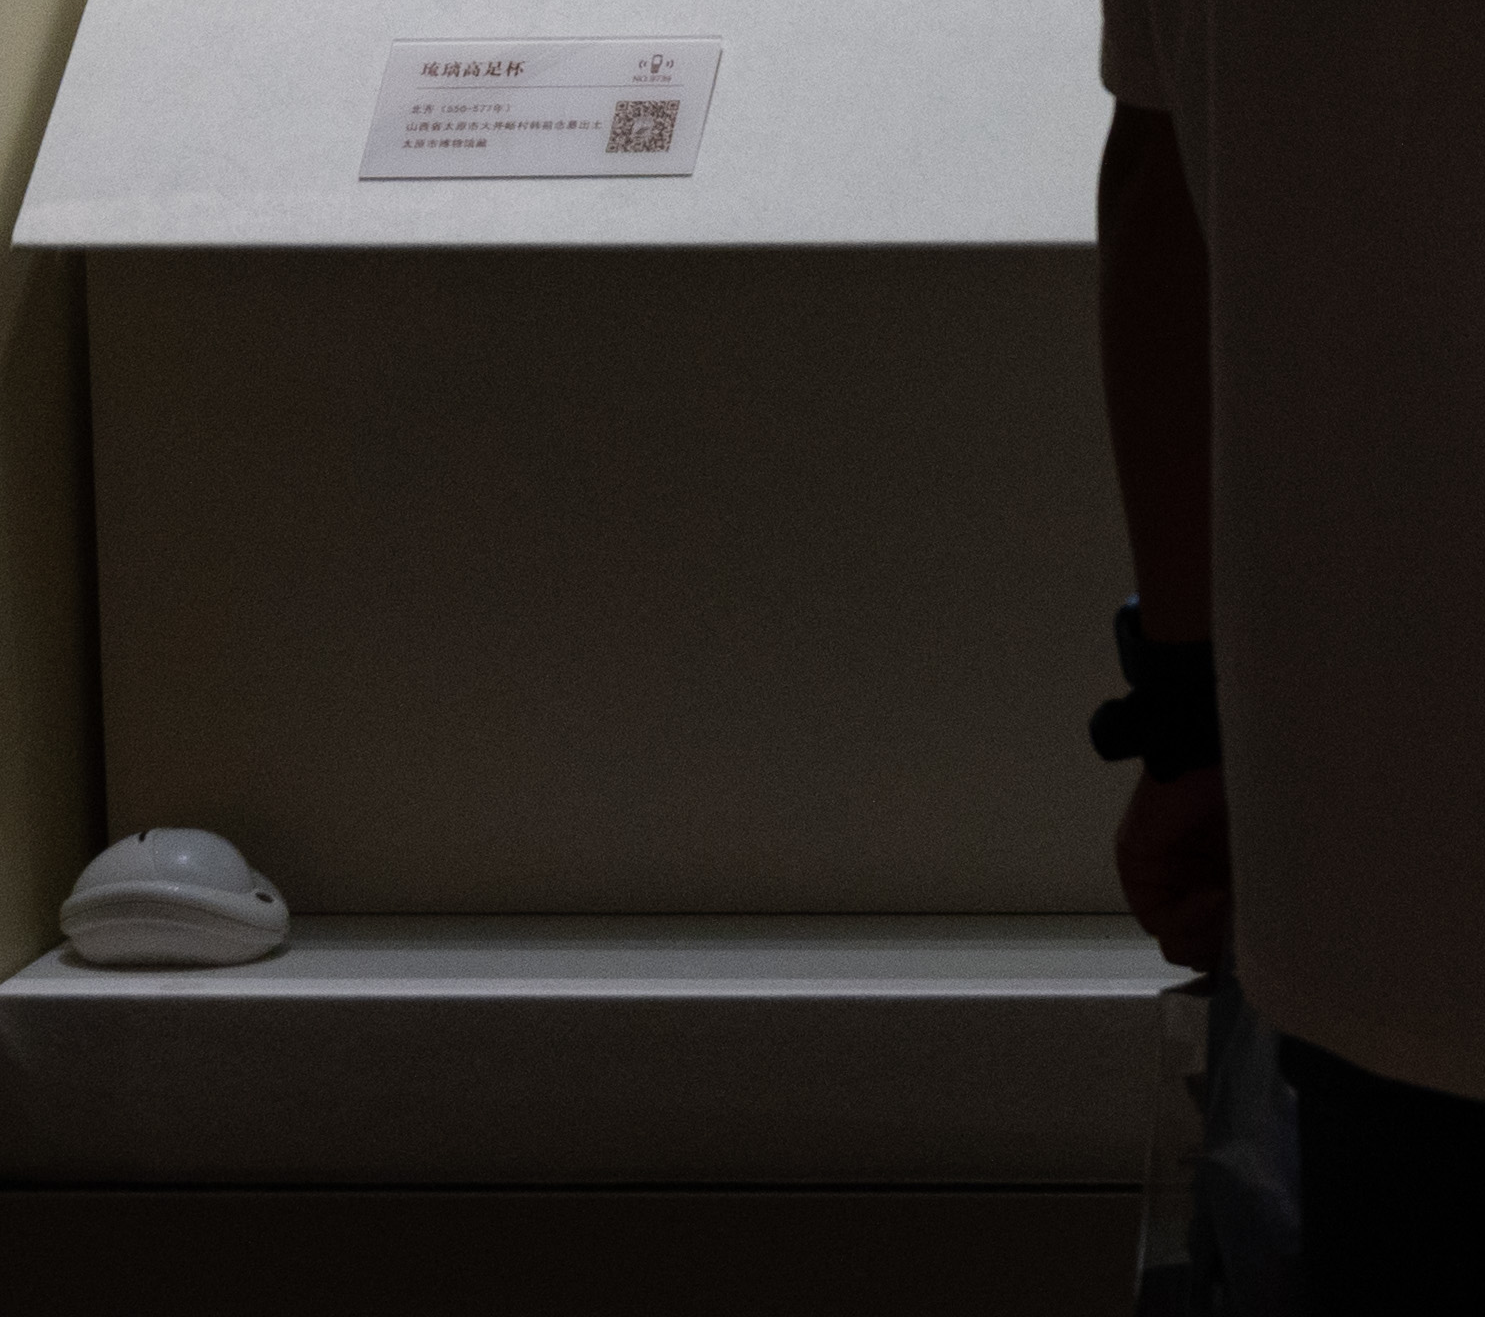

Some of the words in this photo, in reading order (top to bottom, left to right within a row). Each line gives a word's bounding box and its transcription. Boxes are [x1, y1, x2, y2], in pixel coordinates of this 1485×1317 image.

[419, 58, 527, 79] 琉璃高足杯
